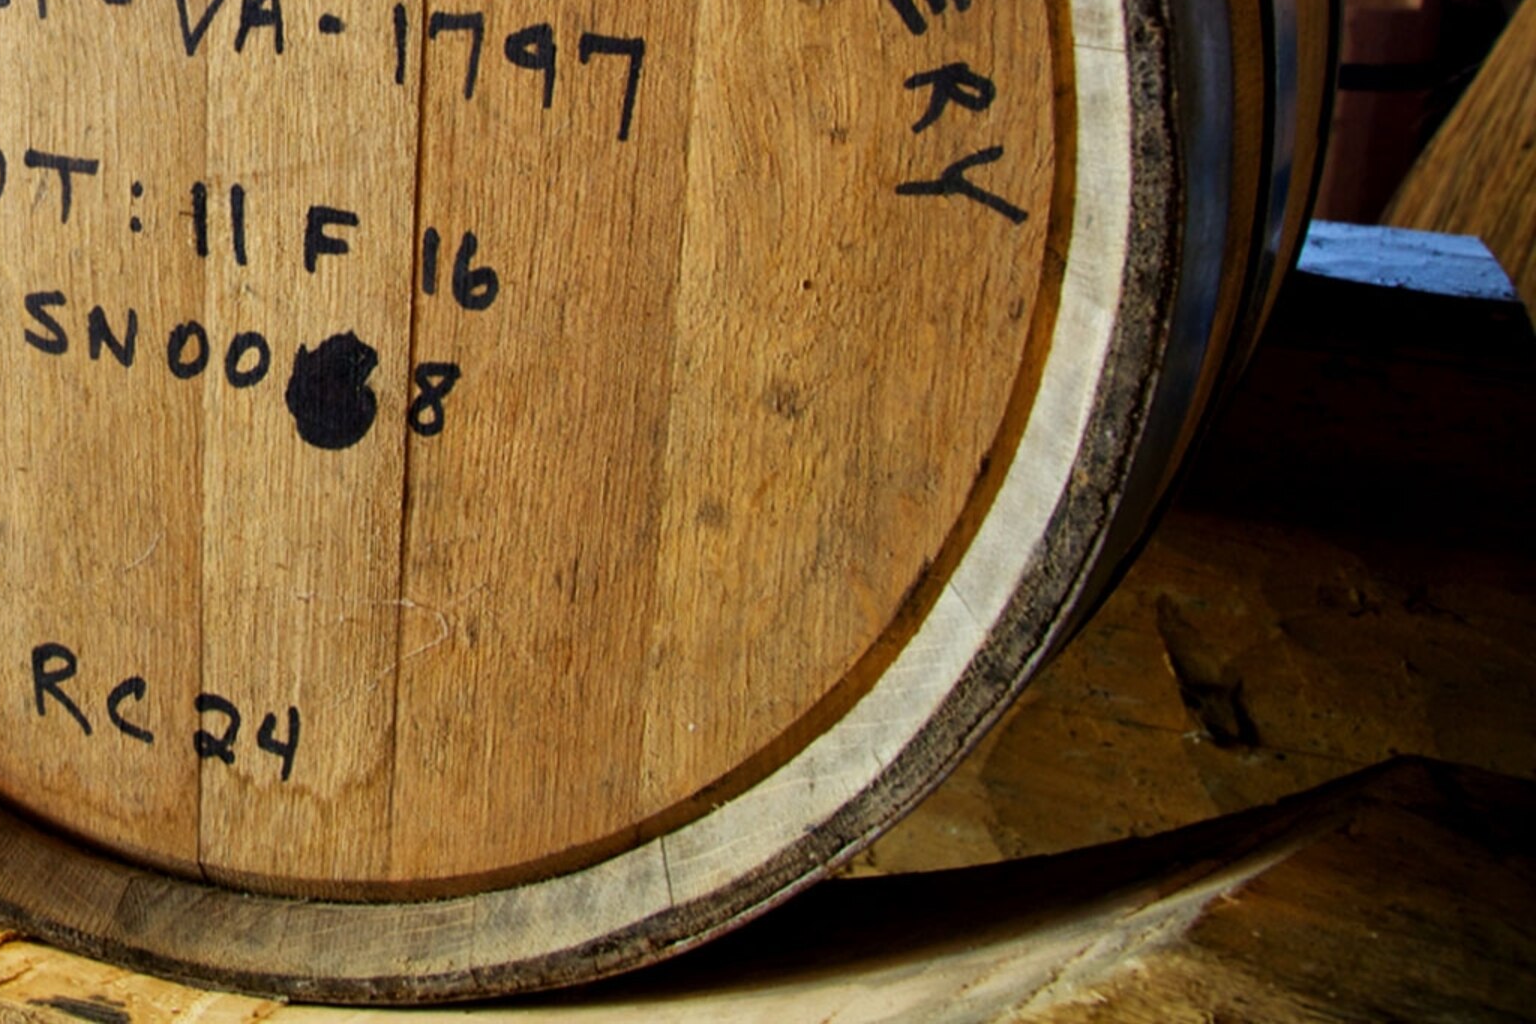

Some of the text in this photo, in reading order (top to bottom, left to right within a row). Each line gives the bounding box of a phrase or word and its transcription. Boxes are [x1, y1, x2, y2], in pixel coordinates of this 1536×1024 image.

[303, 205, 360, 274] F
[421, 225, 501, 312] 16
[192, 692, 301, 782] 24
